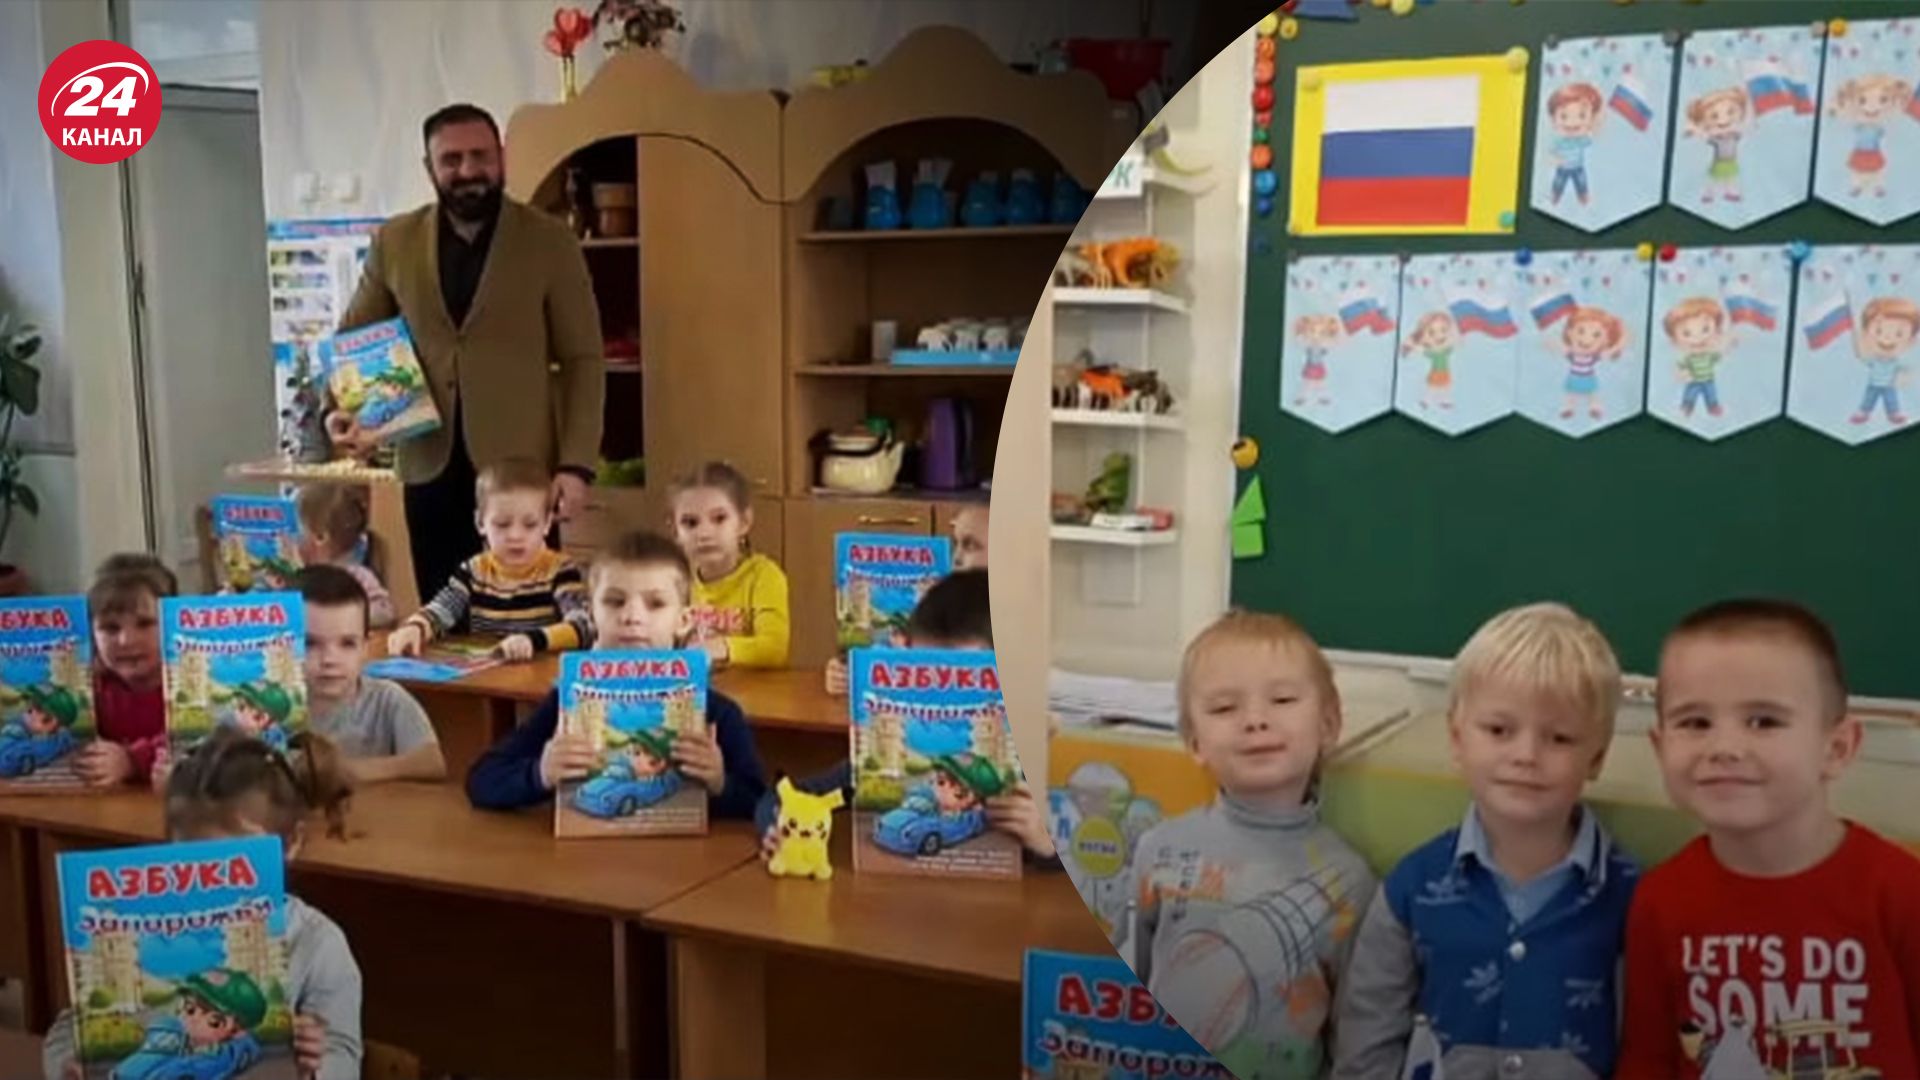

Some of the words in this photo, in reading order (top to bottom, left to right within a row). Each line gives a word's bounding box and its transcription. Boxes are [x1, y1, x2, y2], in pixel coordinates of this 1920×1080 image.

[178, 604, 287, 628] АЗБУКА
[580, 660, 690, 679] АЗБУКА
[870, 662, 1000, 691] АЗБУКА
[88, 855, 258, 898] АЗБУКА
[1681, 934, 1786, 978] LET'S
[1802, 937, 1866, 980] DO
[1057, 974, 1178, 1028] АЗБ
[1688, 975, 1871, 1047] SOME
